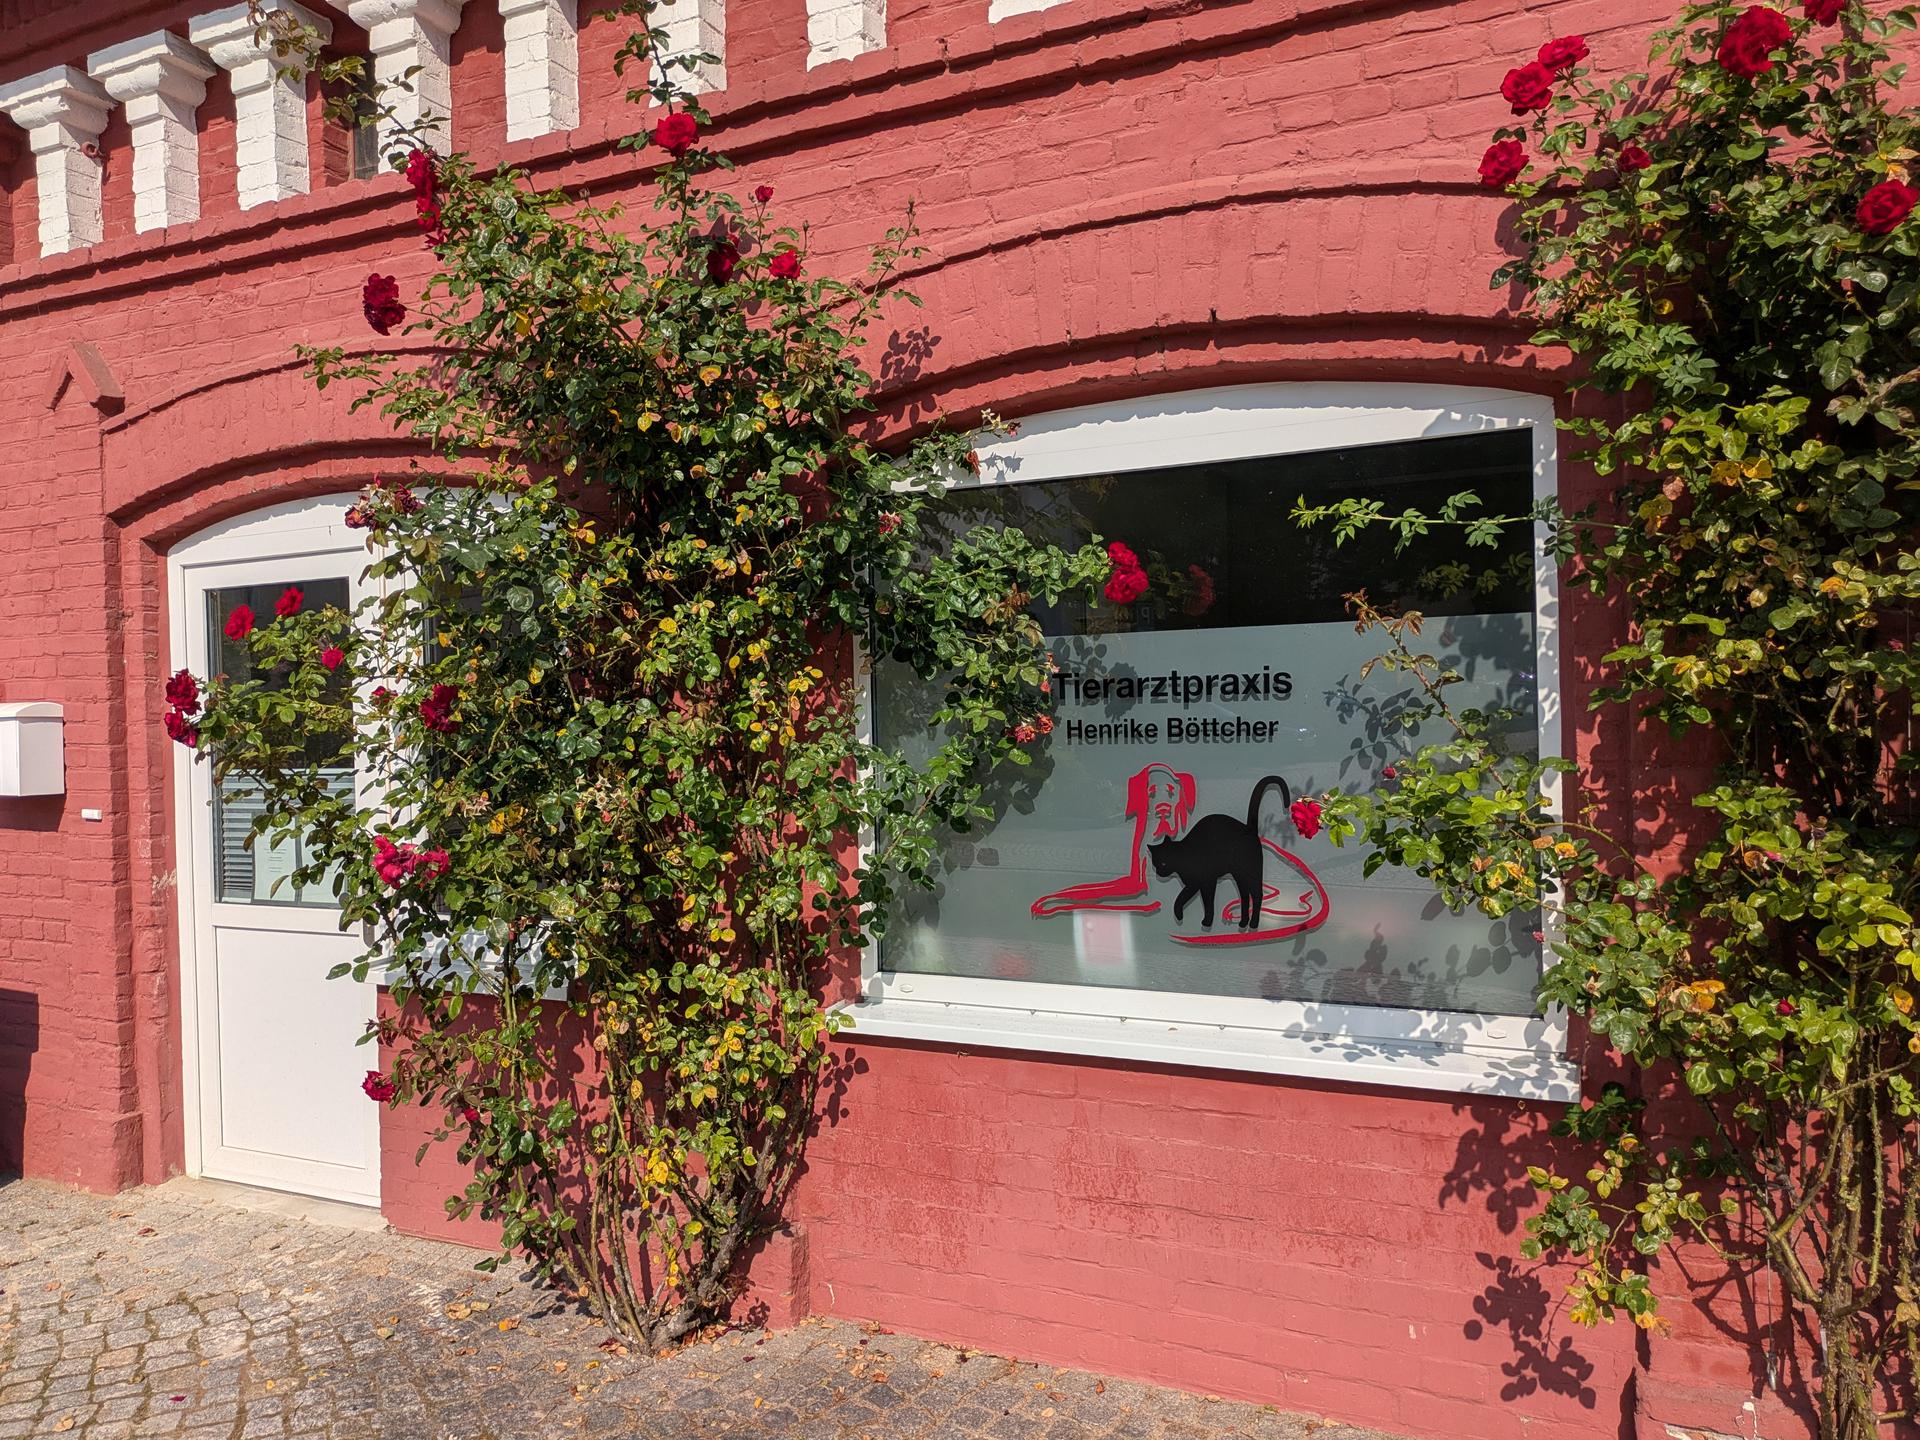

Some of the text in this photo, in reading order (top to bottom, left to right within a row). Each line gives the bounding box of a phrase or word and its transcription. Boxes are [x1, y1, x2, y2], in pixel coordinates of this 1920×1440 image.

[1052, 665, 1293, 704] Tierarztpraxis
[1066, 716, 1279, 739] Henrike Böttcher
